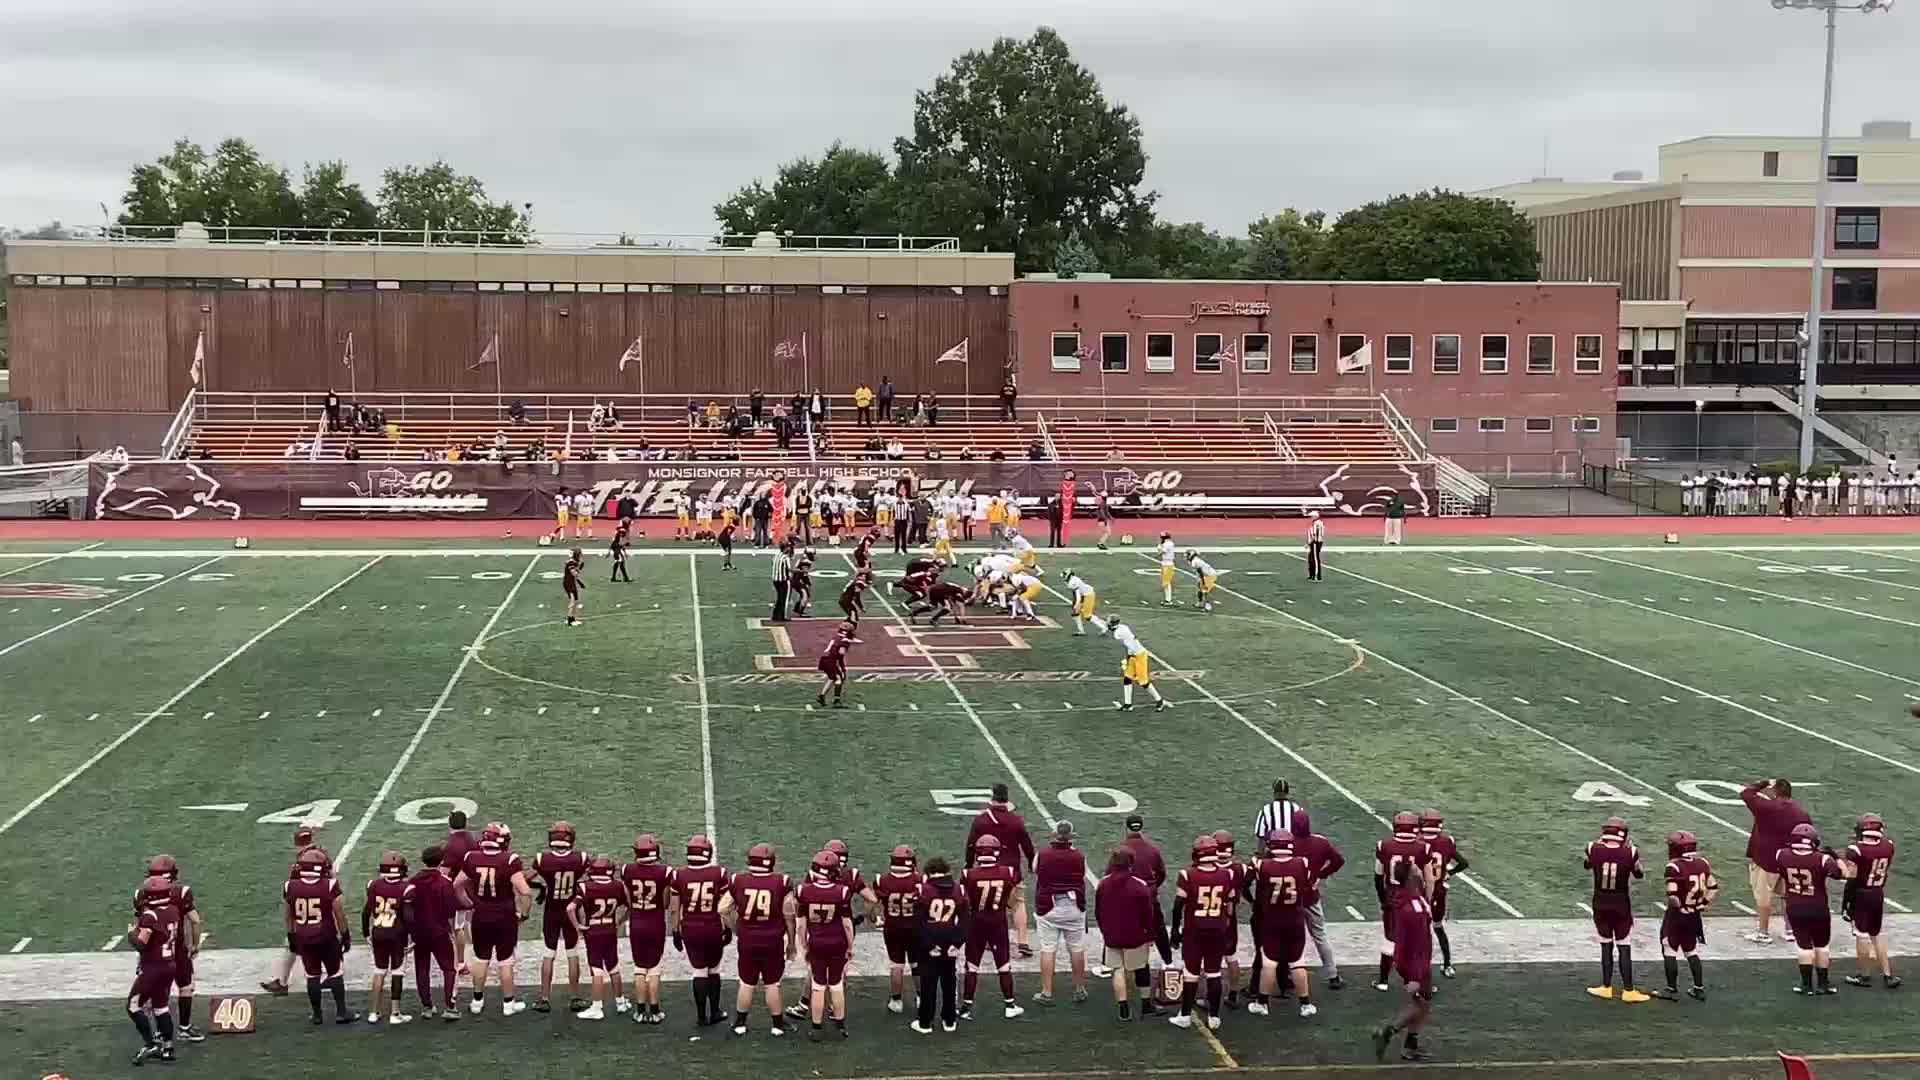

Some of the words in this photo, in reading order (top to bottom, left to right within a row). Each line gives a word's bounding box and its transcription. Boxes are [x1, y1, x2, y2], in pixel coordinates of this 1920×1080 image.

[410, 470, 452, 490] GO
[648, 467, 741, 478] MONSIGNOR
[820, 467, 854, 477] HIGH
[1143, 470, 1182, 489] GO
[590, 479, 696, 516] THE
[257, 797, 478, 828] 40
[929, 787, 1139, 814] 50
[476, 866, 497, 897] 71
[553, 871, 575, 900] 10
[1269, 876, 1297, 905] 73
[1601, 862, 1618, 890] 11
[632, 879, 657, 910] 32
[743, 889, 771, 920] 79
[1194, 886, 1223, 917] 56
[295, 898, 323, 925] 95
[213, 998, 252, 1029] 40
